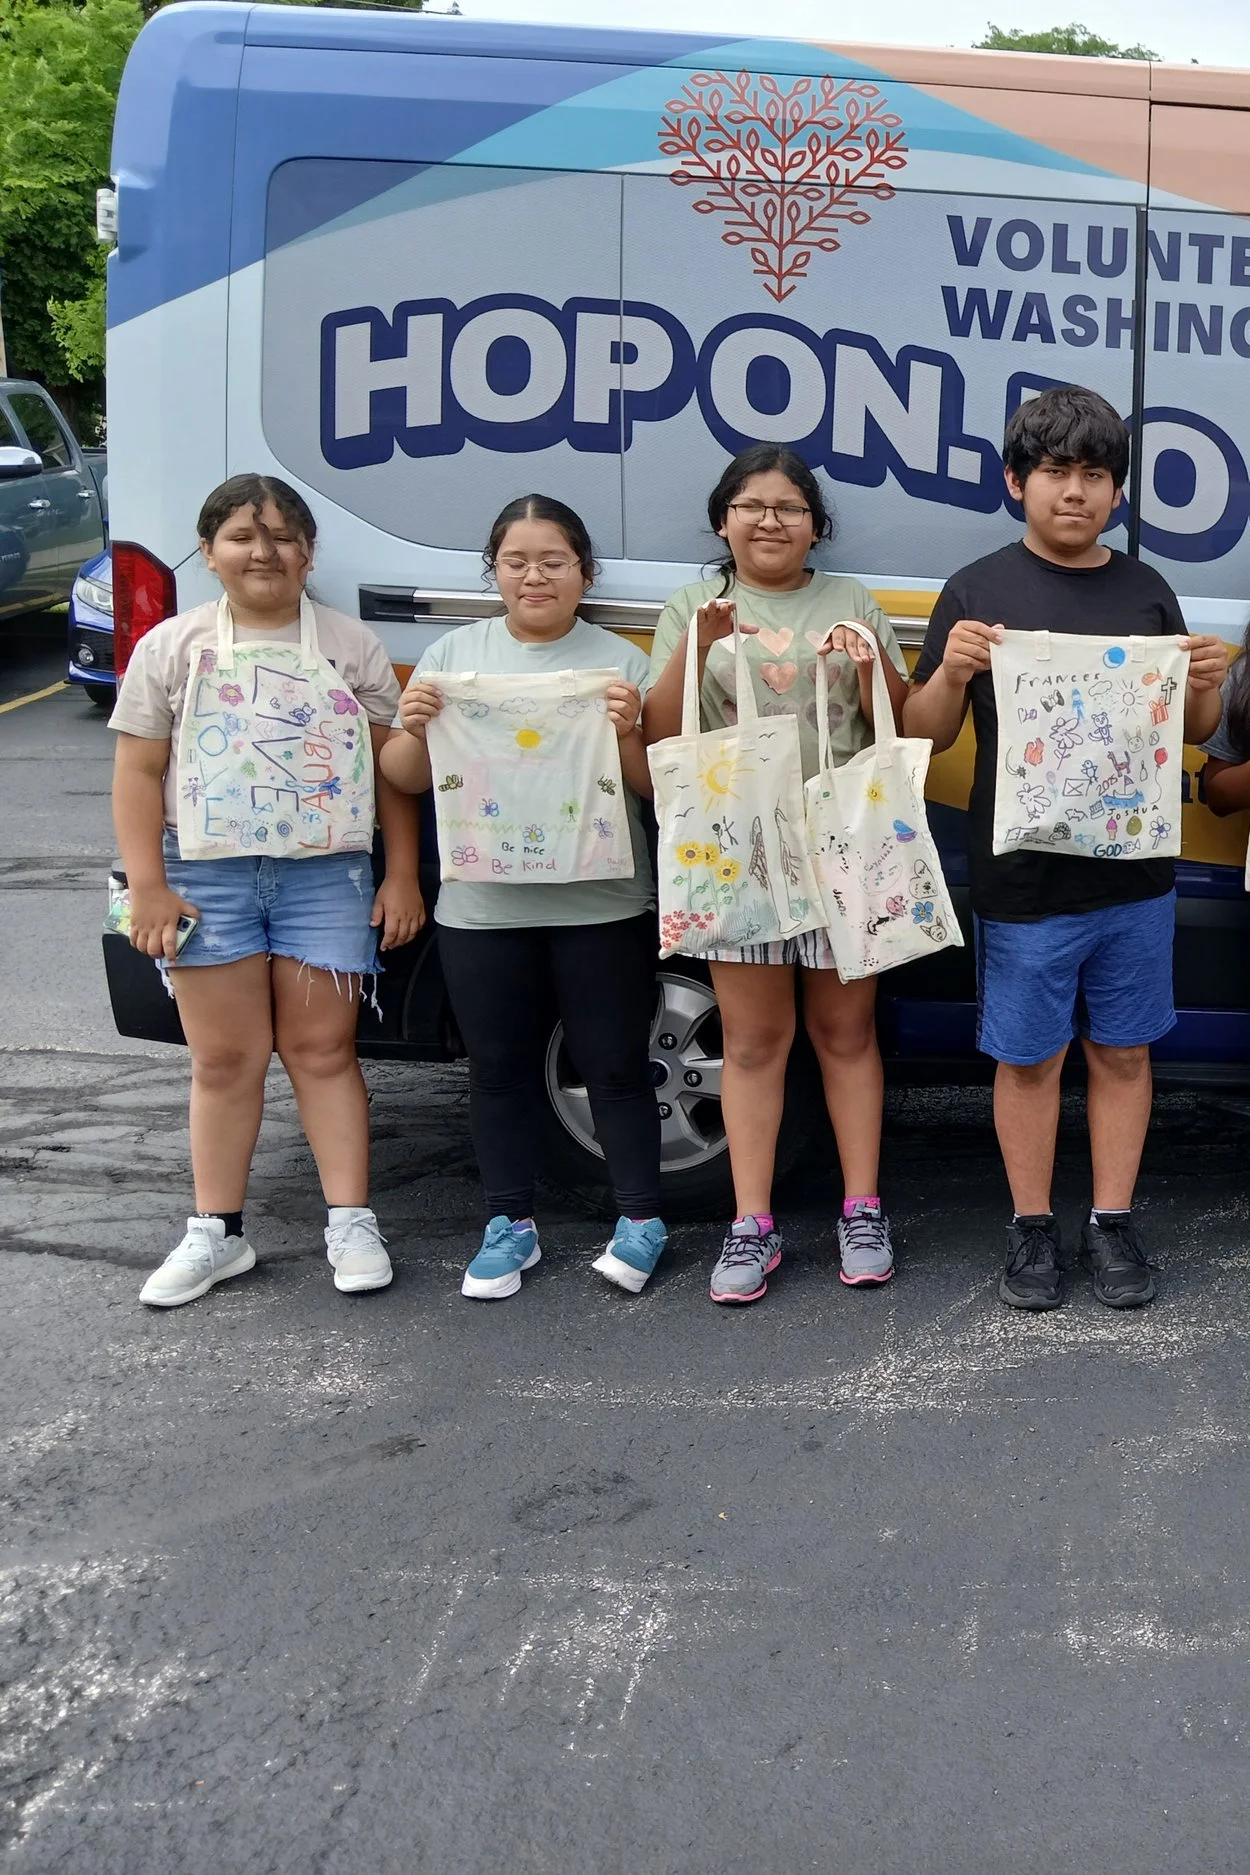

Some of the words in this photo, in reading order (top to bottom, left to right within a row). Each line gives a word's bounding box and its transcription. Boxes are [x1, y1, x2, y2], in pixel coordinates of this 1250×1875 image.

[324, 298, 688, 465] HOP
[702, 317, 1000, 509] ON.
[1008, 380, 1246, 560] O
[1107, 804, 1160, 821] JOSHUA
[1093, 843, 1123, 857] GOD
[491, 858, 513, 876] Be
